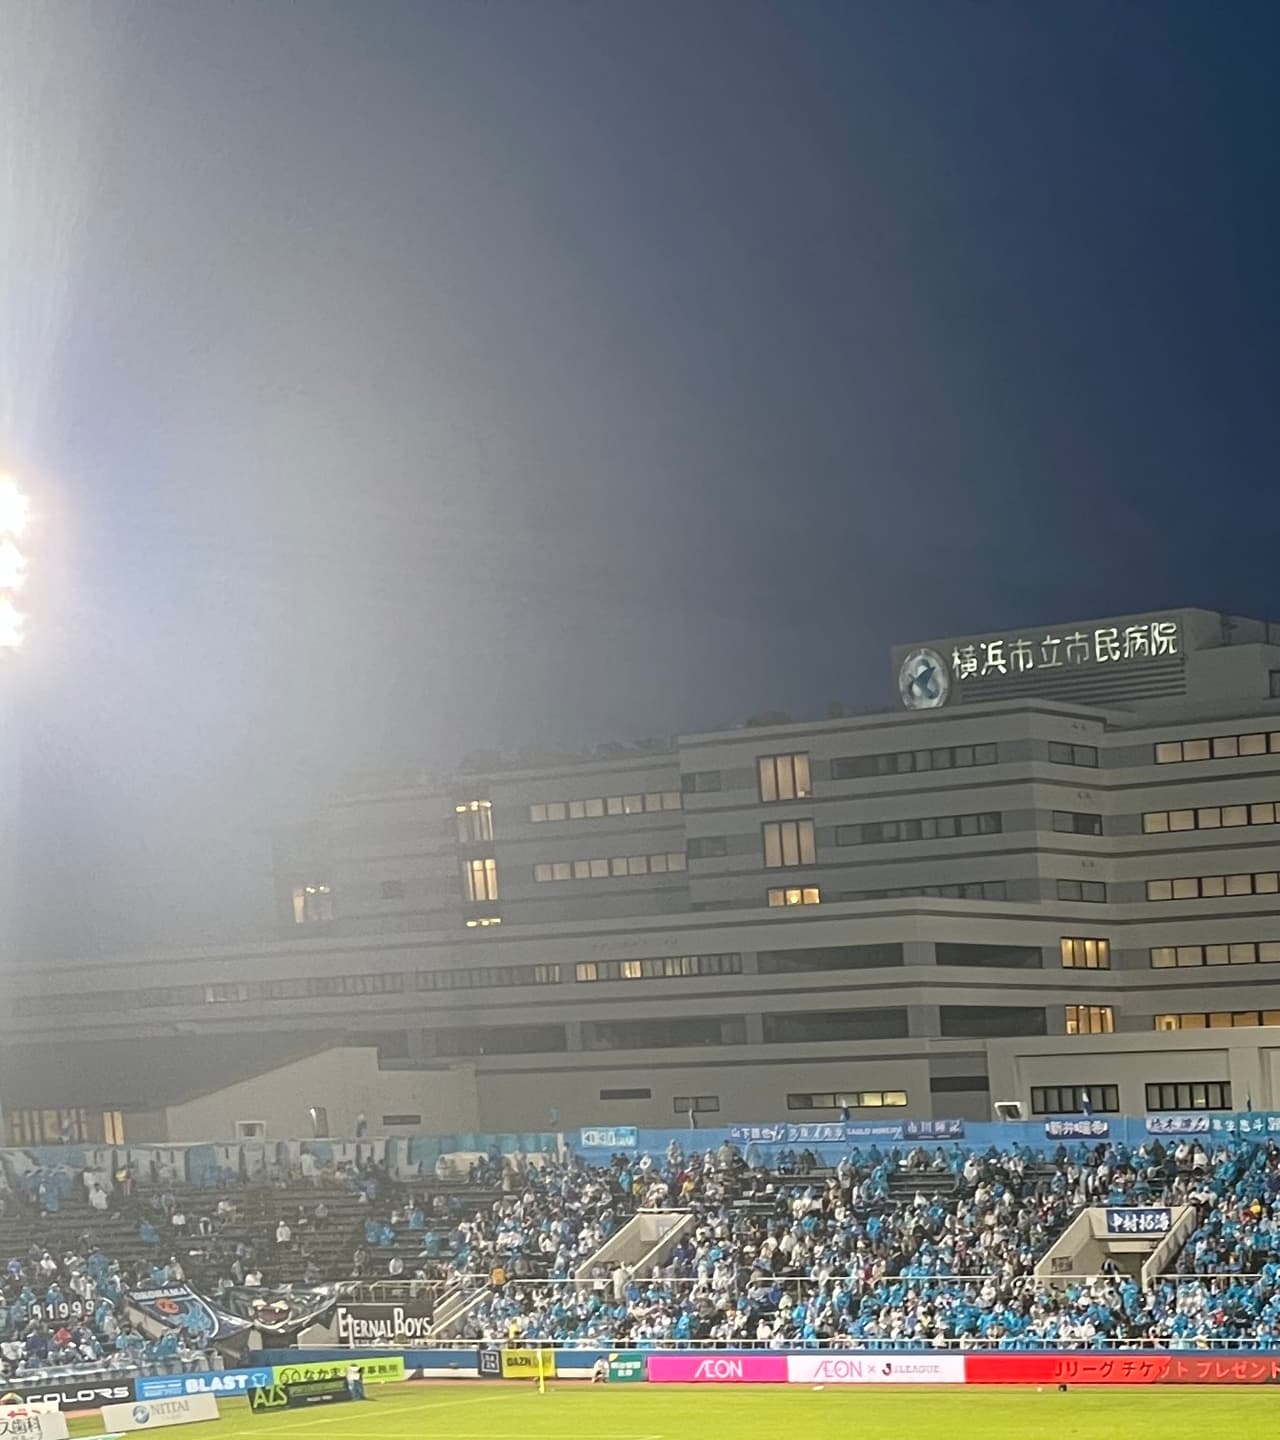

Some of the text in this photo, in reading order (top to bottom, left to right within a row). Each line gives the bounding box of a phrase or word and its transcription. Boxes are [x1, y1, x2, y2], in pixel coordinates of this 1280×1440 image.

[952, 622, 1178, 680] 横浜市立市民病院
[1109, 1212, 1170, 1232] 中村拓海
[394, 1307, 431, 1337] BOYS
[185, 1375, 248, 1394] BLAST
[27, 1386, 129, 1404] COLORS
